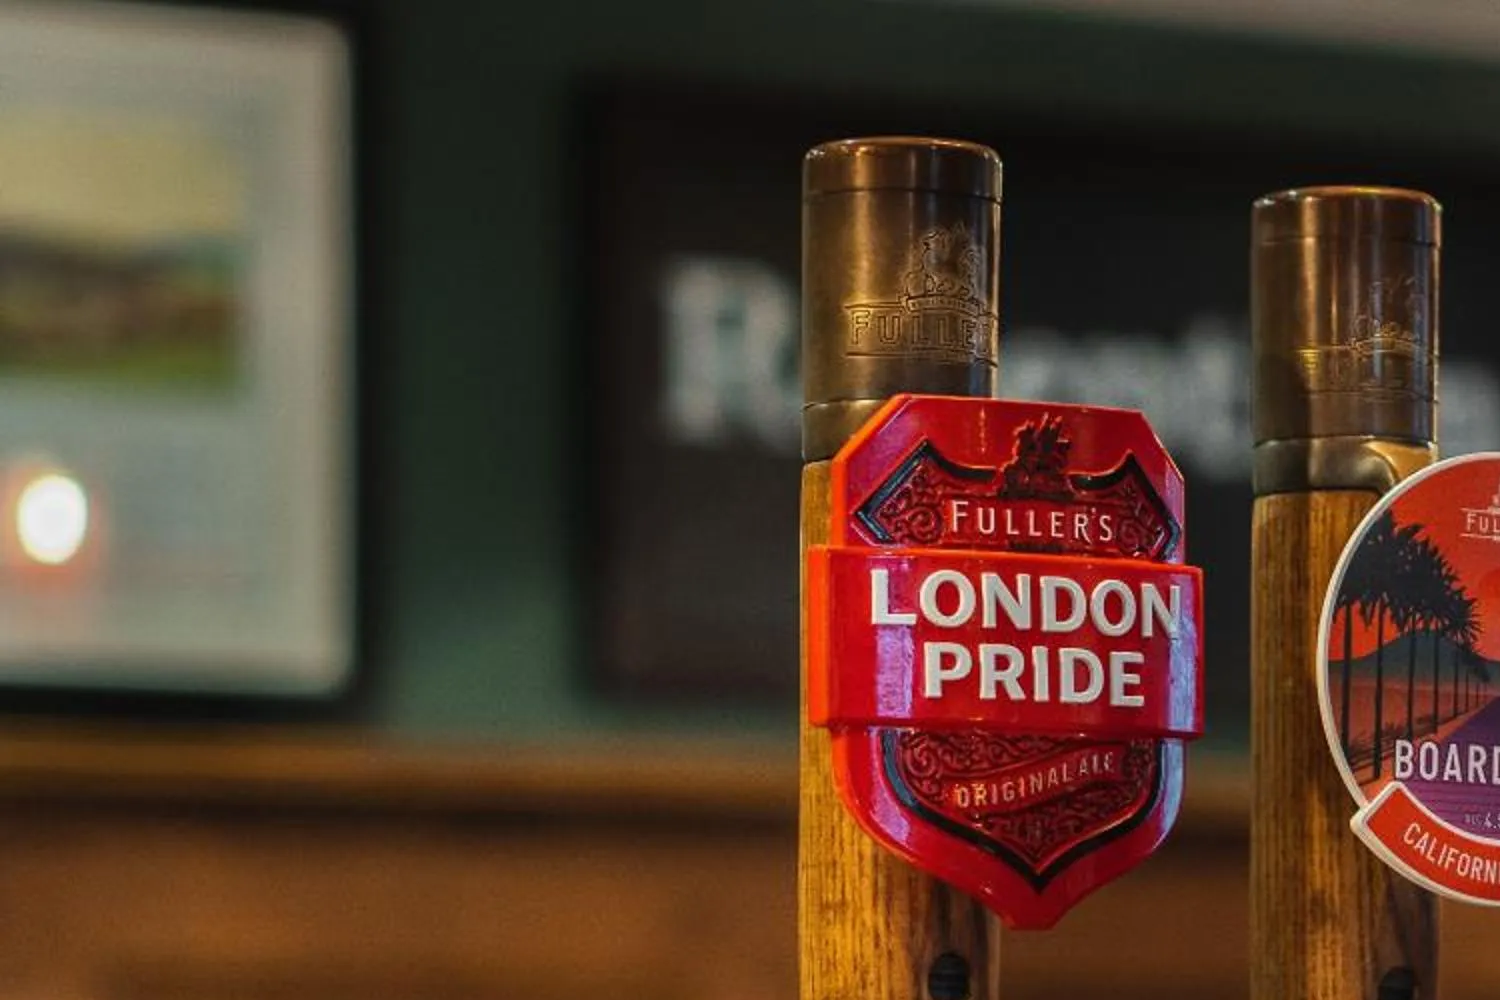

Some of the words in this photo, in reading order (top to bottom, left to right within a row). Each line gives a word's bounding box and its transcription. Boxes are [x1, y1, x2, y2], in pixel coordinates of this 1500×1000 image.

[949, 501, 1114, 545] FULLER'S
[869, 568, 1181, 640] LONDON
[922, 641, 1146, 708] PRIDE
[955, 762, 1073, 808] ORIGINAL
